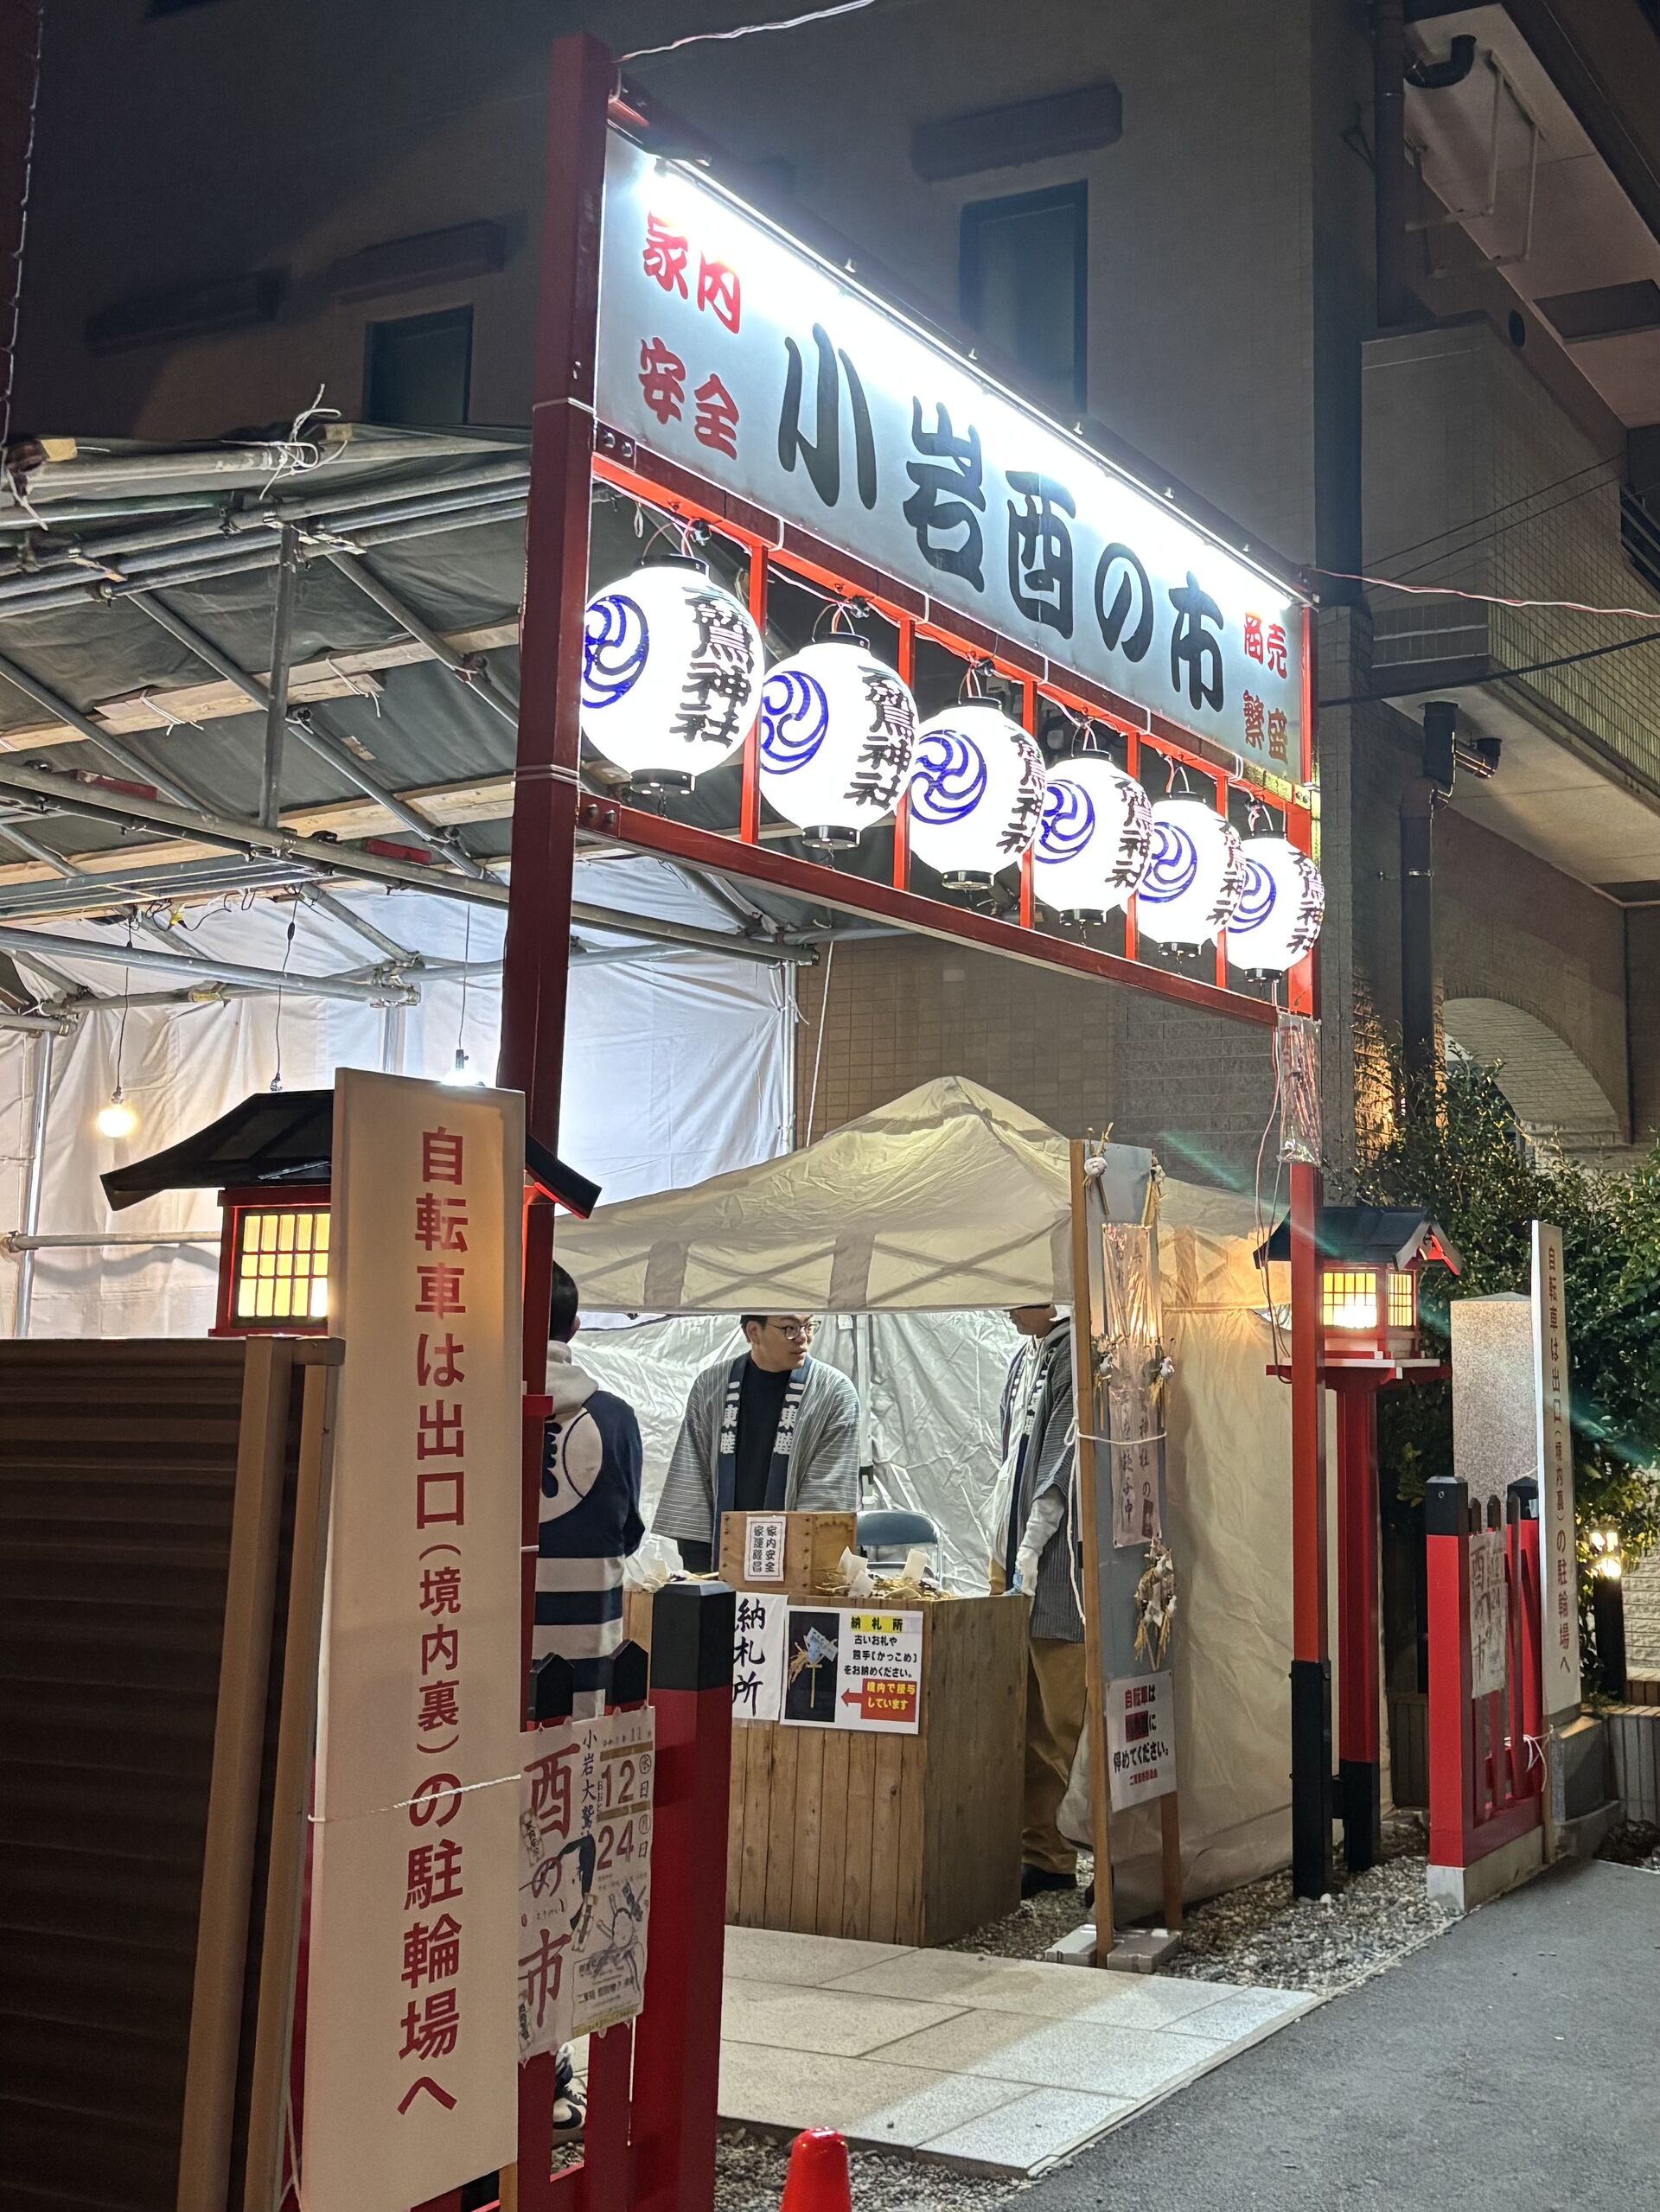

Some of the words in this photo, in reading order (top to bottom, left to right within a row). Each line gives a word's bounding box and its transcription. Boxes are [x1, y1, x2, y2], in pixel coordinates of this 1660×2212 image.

[642, 210, 741, 334] 家内
[638, 336, 739, 461] 安全
[777, 322, 1224, 713] 小岩酉の市
[1243, 611, 1288, 679] 商売
[1242, 689, 1289, 765] 繁盛
[734, 1598, 767, 1718] 納札所
[854, 1635, 897, 1647] 古いお札や
